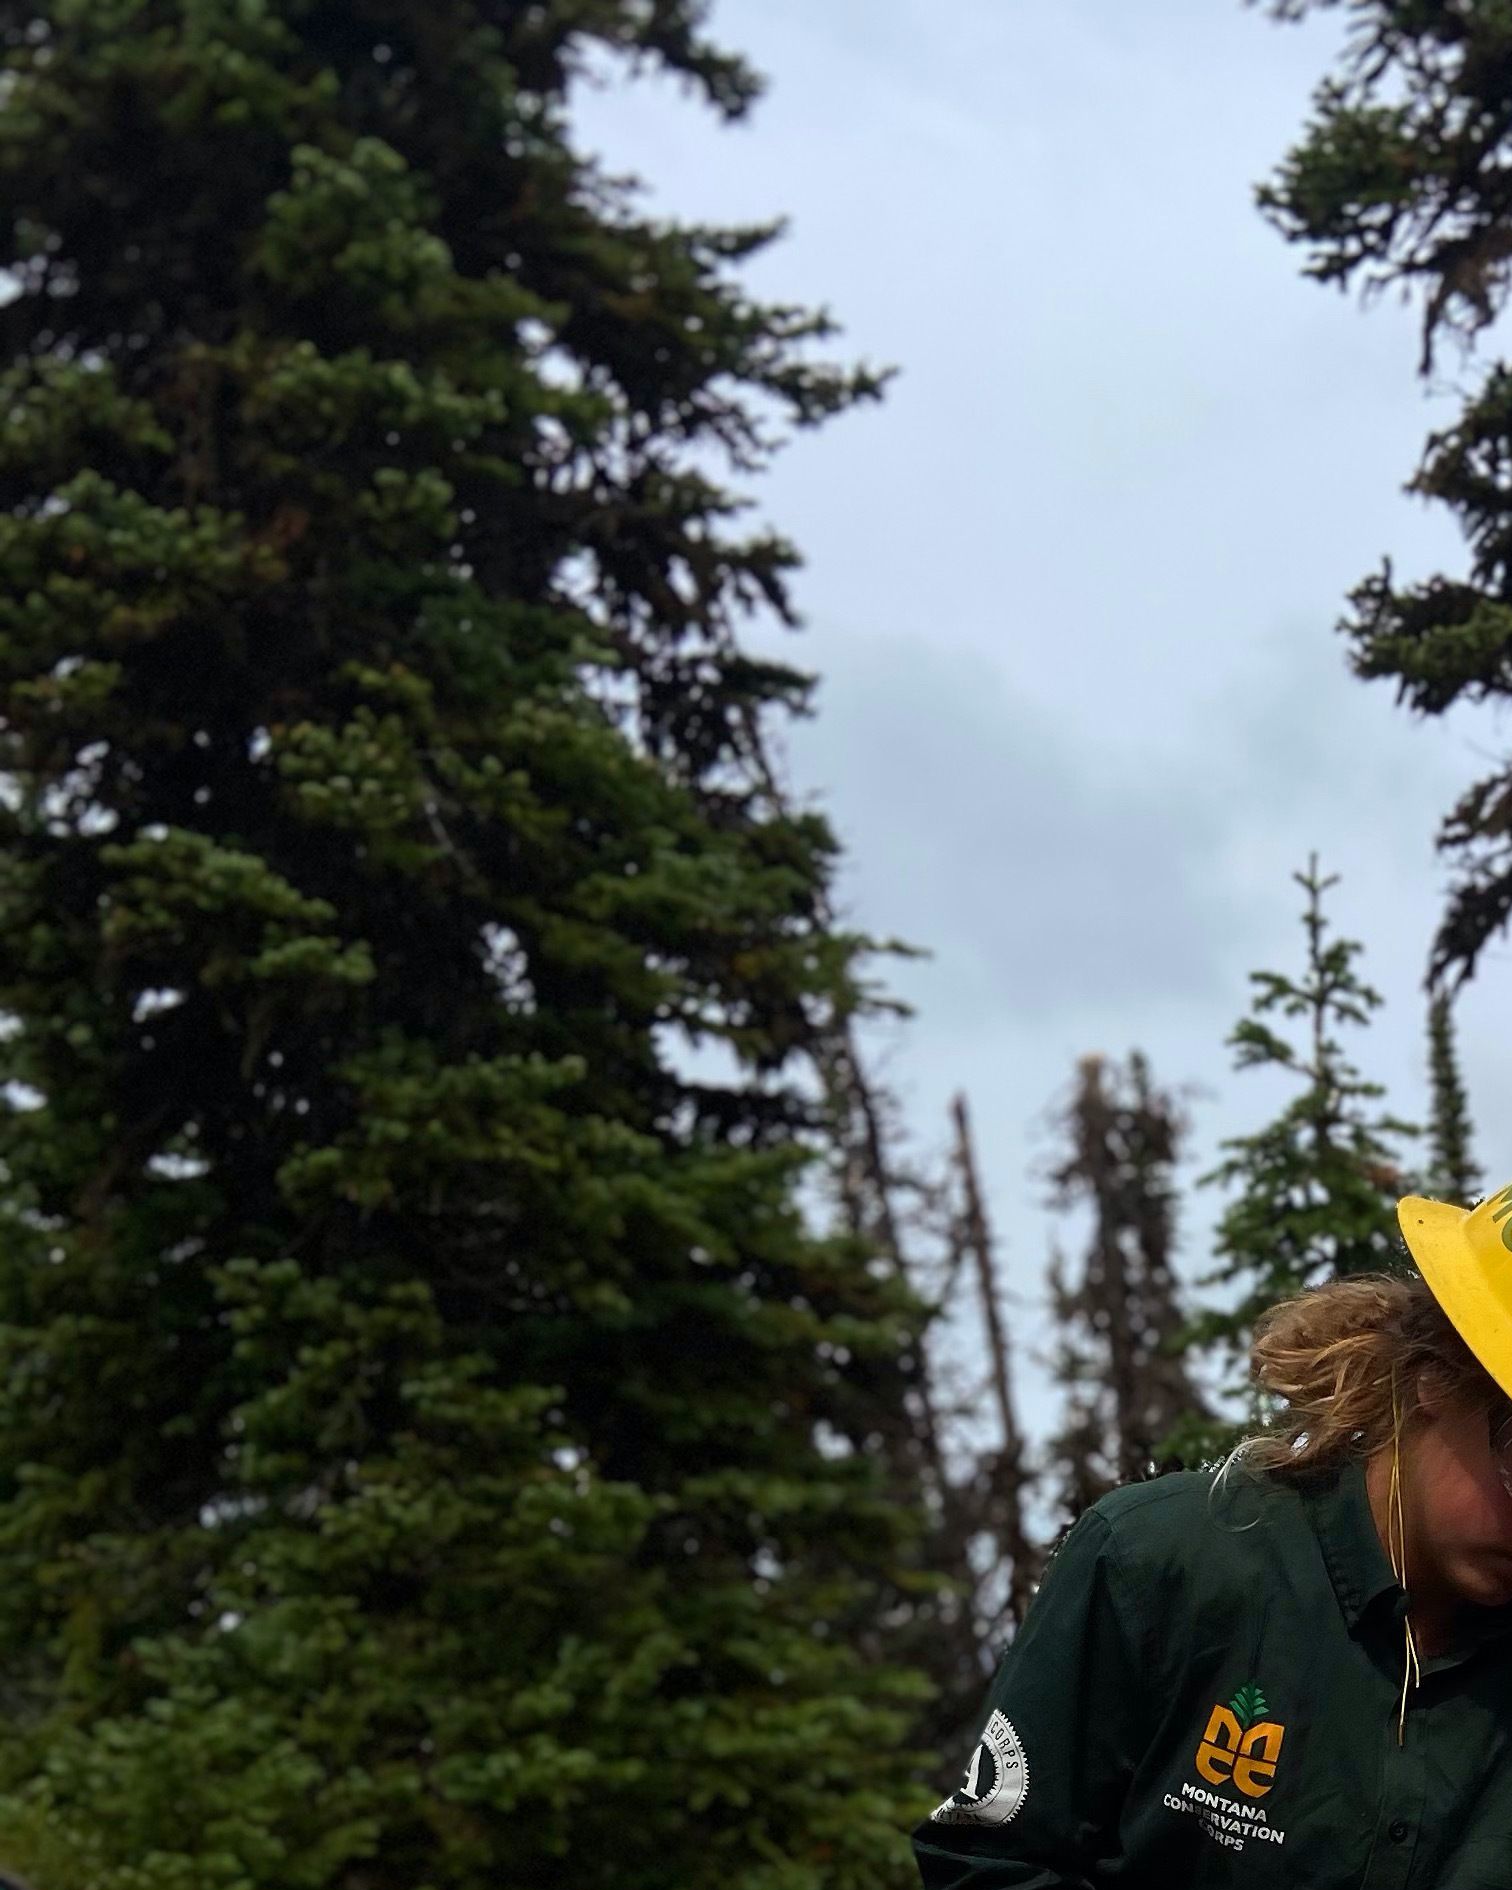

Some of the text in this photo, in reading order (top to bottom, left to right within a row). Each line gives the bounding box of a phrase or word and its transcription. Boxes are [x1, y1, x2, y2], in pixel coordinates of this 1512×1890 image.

[990, 1721, 1019, 1769] CORPS
[1163, 1793, 1285, 1844] CONSERVATION
[1181, 1782, 1267, 1822] MONTANA
[1199, 1819, 1245, 1851] CORPS
